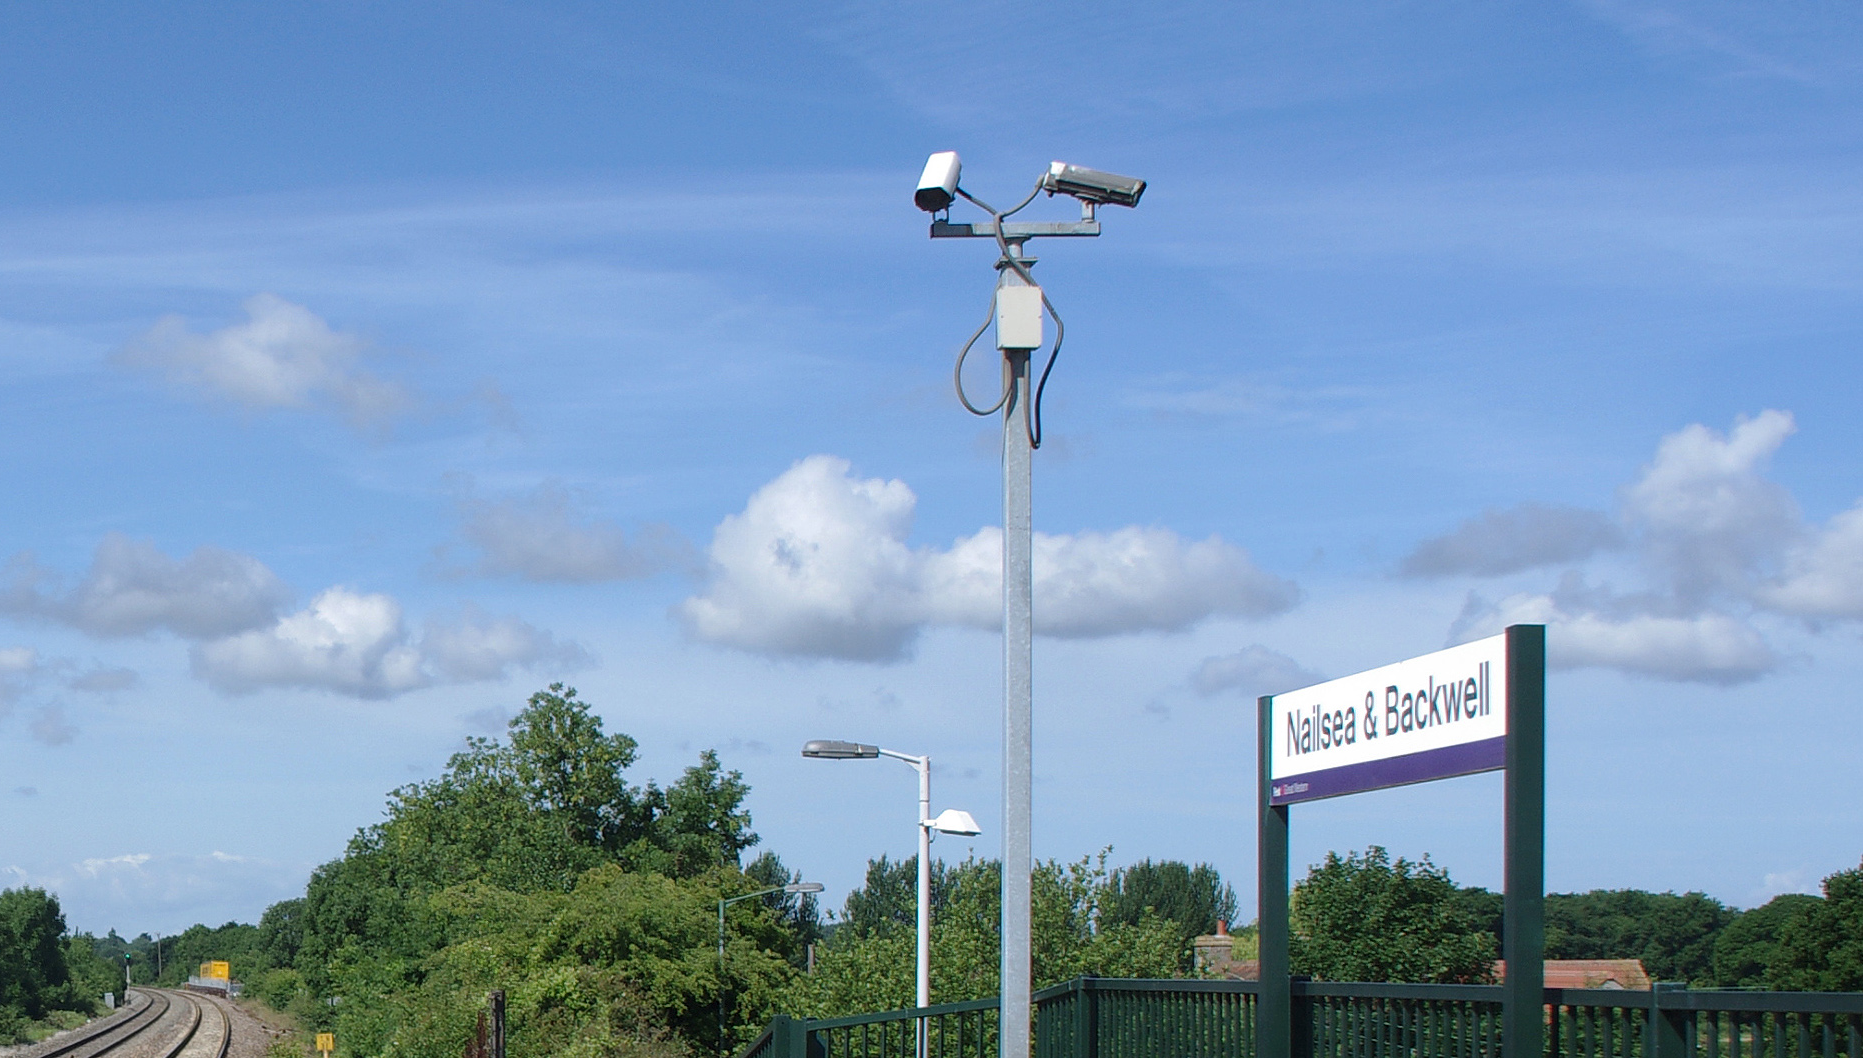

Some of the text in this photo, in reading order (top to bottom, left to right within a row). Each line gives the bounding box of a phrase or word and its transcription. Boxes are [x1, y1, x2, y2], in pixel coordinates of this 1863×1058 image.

[1287, 660, 1490, 757] Nailsea & Backwell
